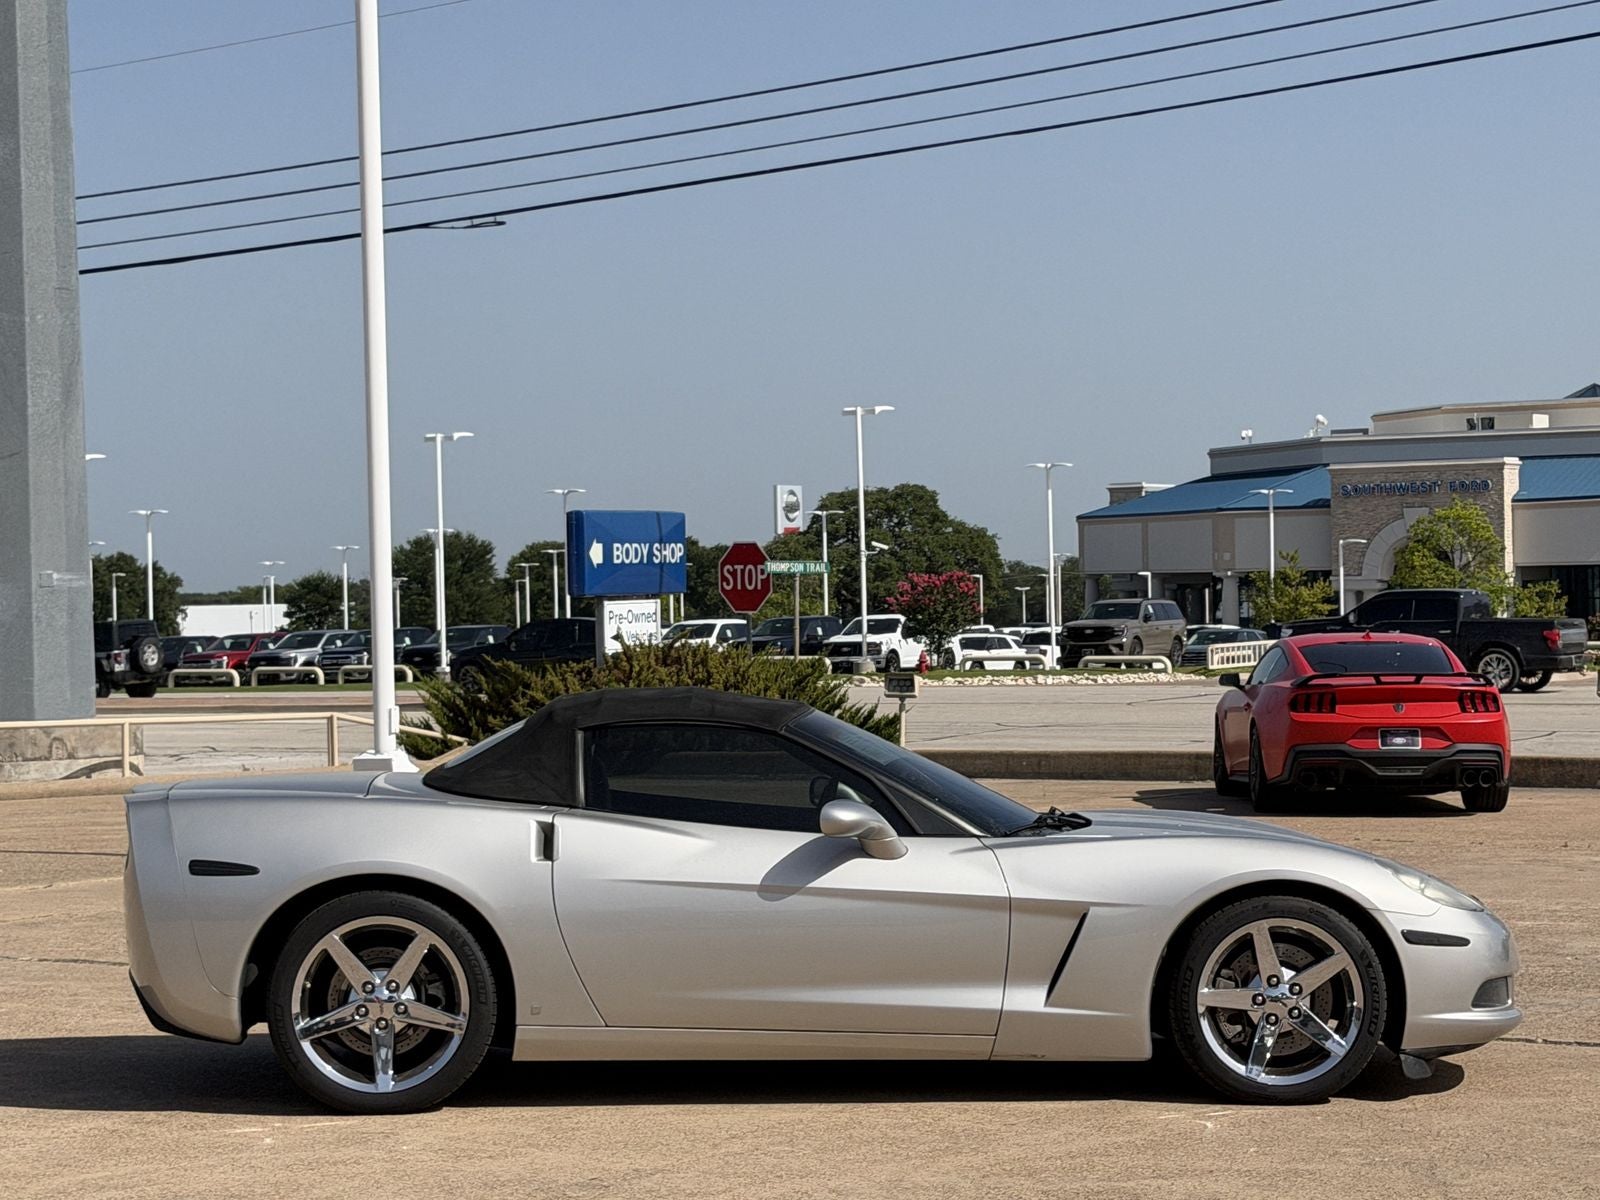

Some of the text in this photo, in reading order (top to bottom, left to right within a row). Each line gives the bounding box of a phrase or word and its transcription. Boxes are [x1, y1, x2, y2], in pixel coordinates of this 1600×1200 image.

[1340, 479, 1491, 497] SOUTHWEST FORD
[613, 543, 684, 564] BODY SHOP
[722, 564, 768, 590] STOP
[767, 562, 828, 573] THOMPSON TRAIL
[608, 609, 657, 625] Pre-Owned
[1367, 967, 1380, 1034] MICHELIN
